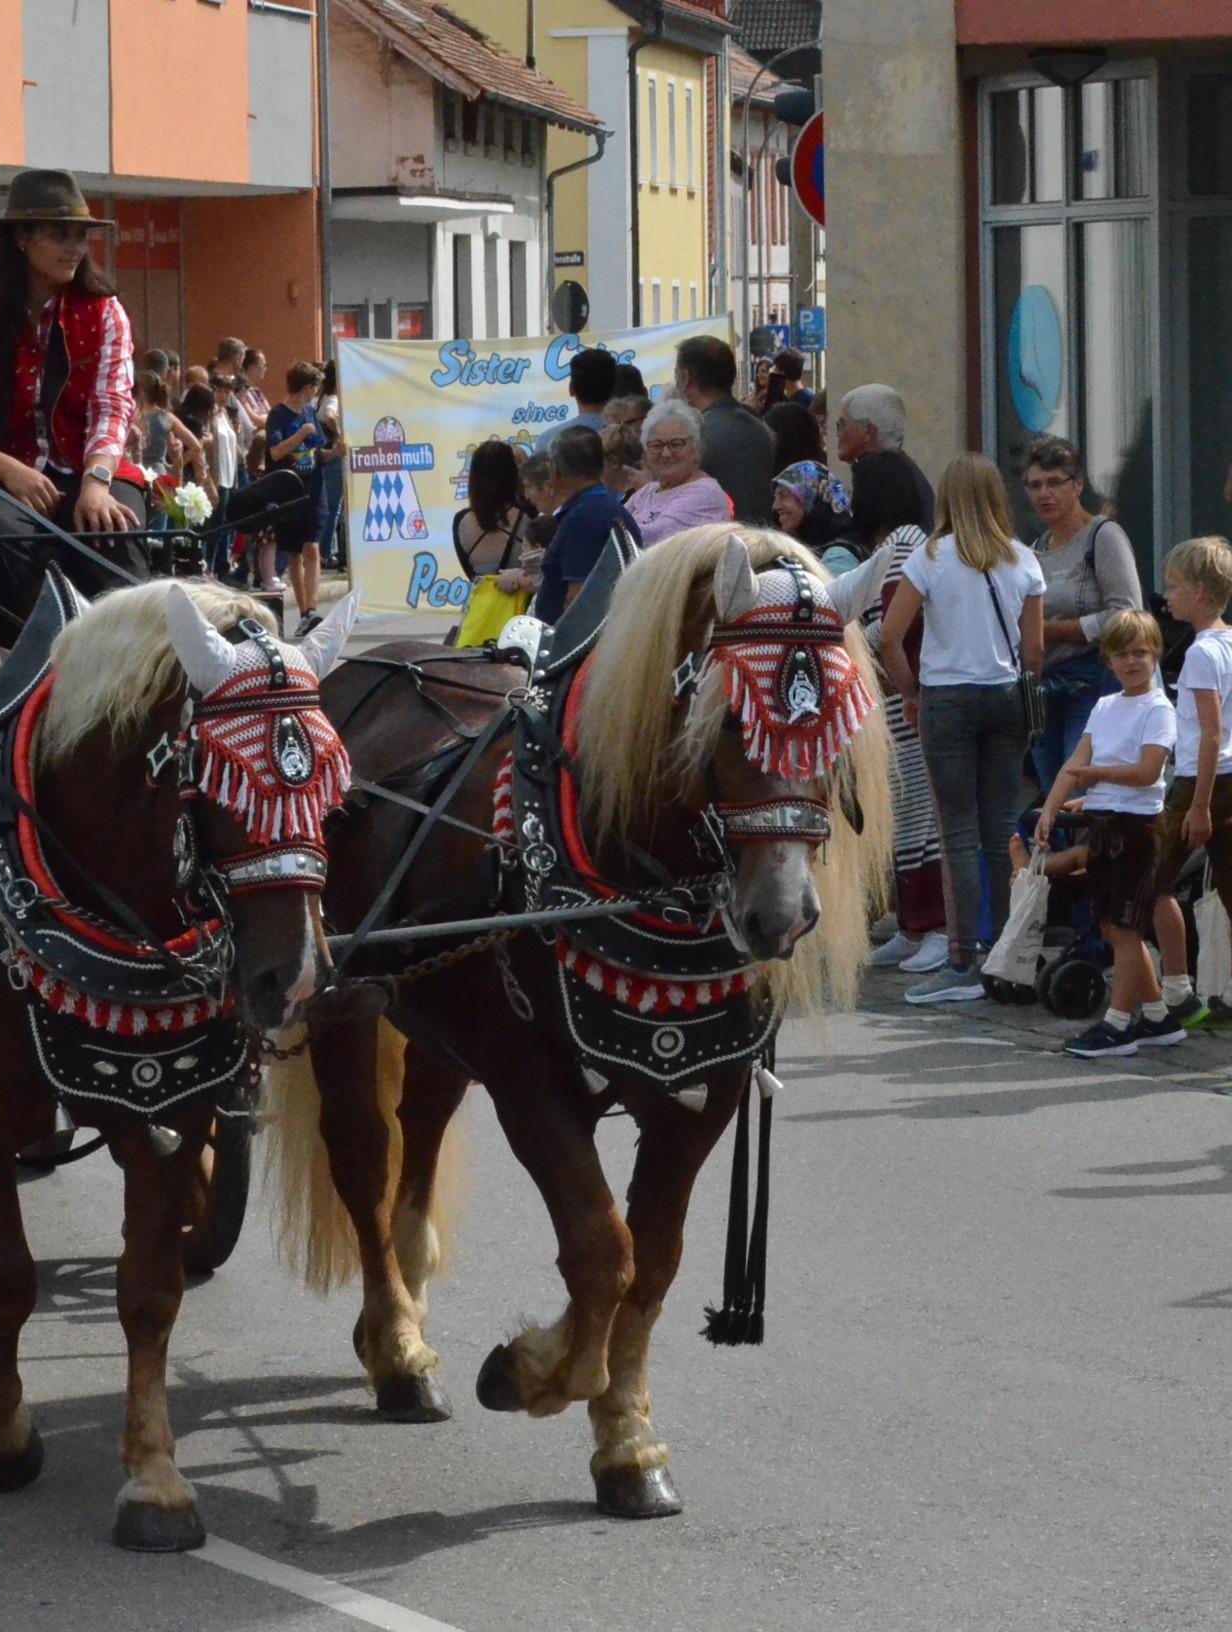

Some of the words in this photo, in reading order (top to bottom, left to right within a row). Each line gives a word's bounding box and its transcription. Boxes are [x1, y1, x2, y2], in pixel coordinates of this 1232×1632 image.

[431, 339, 532, 388] Sister
[512, 402, 569, 425] since
[351, 444, 433, 470] Frankenmuth
[406, 551, 472, 611] Peo
